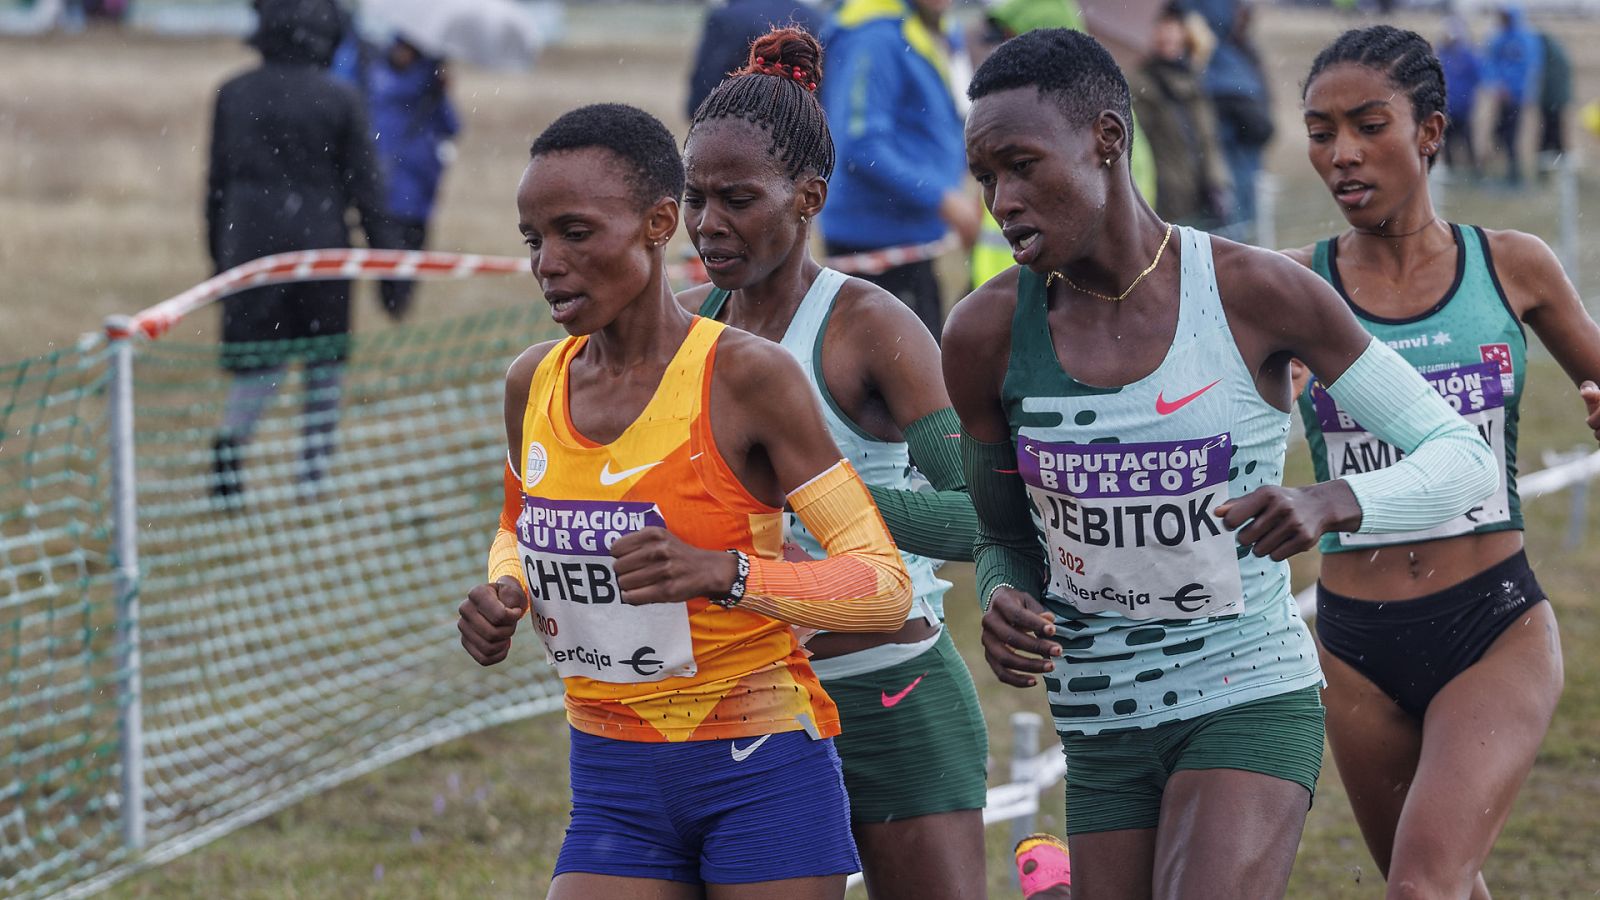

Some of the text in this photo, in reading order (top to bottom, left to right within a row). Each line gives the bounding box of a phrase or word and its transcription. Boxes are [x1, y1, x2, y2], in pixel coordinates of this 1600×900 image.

[1386, 334, 1428, 350] anvi
[1039, 445, 1208, 473] DIPUTACIÓN
[1040, 465, 1208, 494] BURGOS
[524, 506, 646, 531] IPUTACIÓN
[1046, 492, 1221, 548] JEBITOK
[521, 521, 623, 551] BURGO
[1058, 547, 1085, 576] 302
[525, 555, 624, 605] CHEB
[1065, 574, 1150, 611] iberCaja
[536, 613, 559, 637] 300
